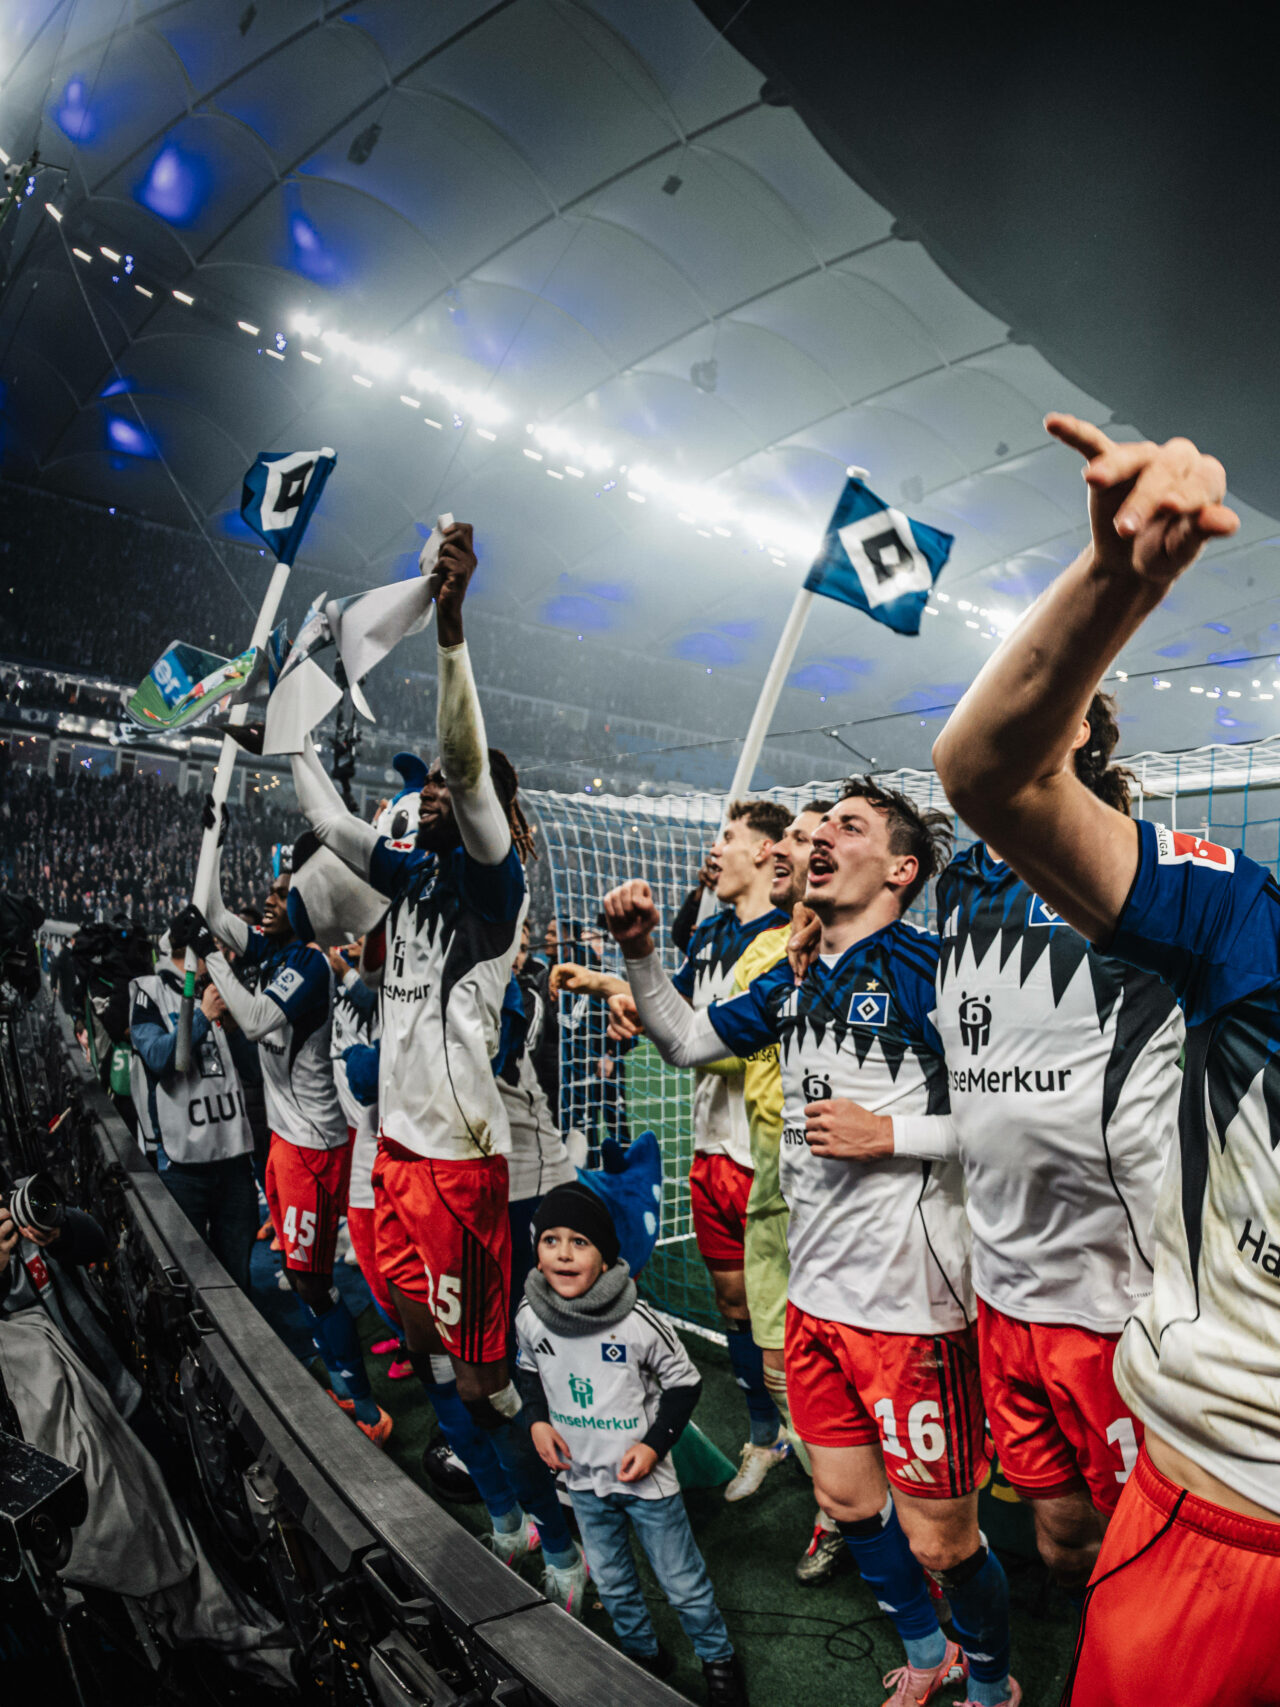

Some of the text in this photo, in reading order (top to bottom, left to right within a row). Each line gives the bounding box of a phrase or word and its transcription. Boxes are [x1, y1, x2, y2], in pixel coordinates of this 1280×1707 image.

[188, 1090, 245, 1127] CLU
[283, 1205, 317, 1247] 45
[874, 1398, 945, 1462] 16
